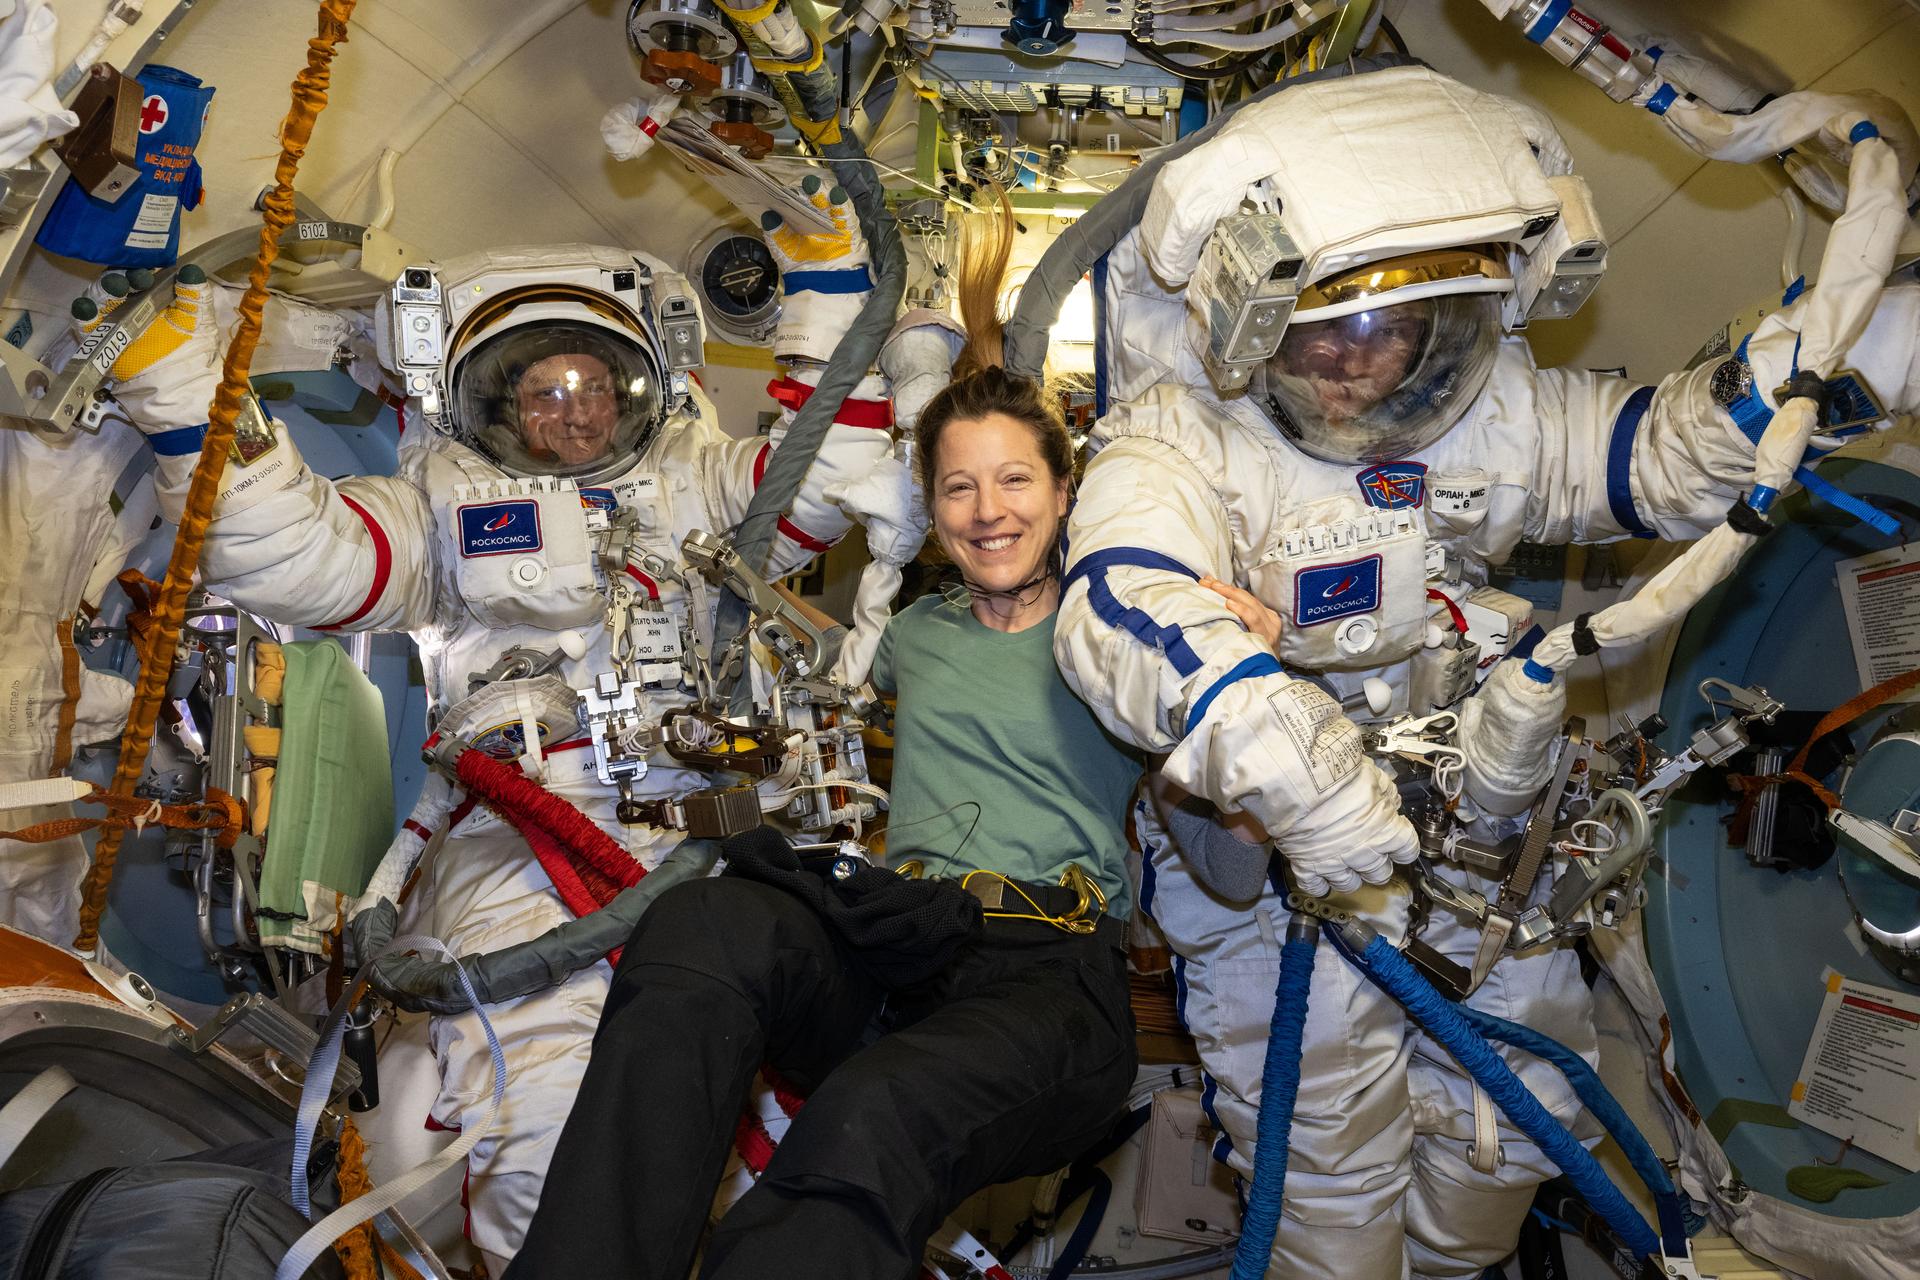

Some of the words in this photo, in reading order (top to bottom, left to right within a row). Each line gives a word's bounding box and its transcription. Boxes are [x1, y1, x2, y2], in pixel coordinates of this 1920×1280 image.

[301, 224, 325, 238] 6102
[76, 325, 111, 355] 6102
[97, 331, 128, 368] 6102
[614, 482, 635, 494] ОРЛАН
[638, 479, 653, 487] МКС
[630, 489, 637, 497] 7
[1435, 489, 1464, 499] ОРЛАН
[1470, 488, 1486, 498] МКС
[1463, 500, 1470, 509] 6
[471, 535, 531, 547] РОСКОСМОС
[1307, 595, 1370, 616] РОСКОСМОС
